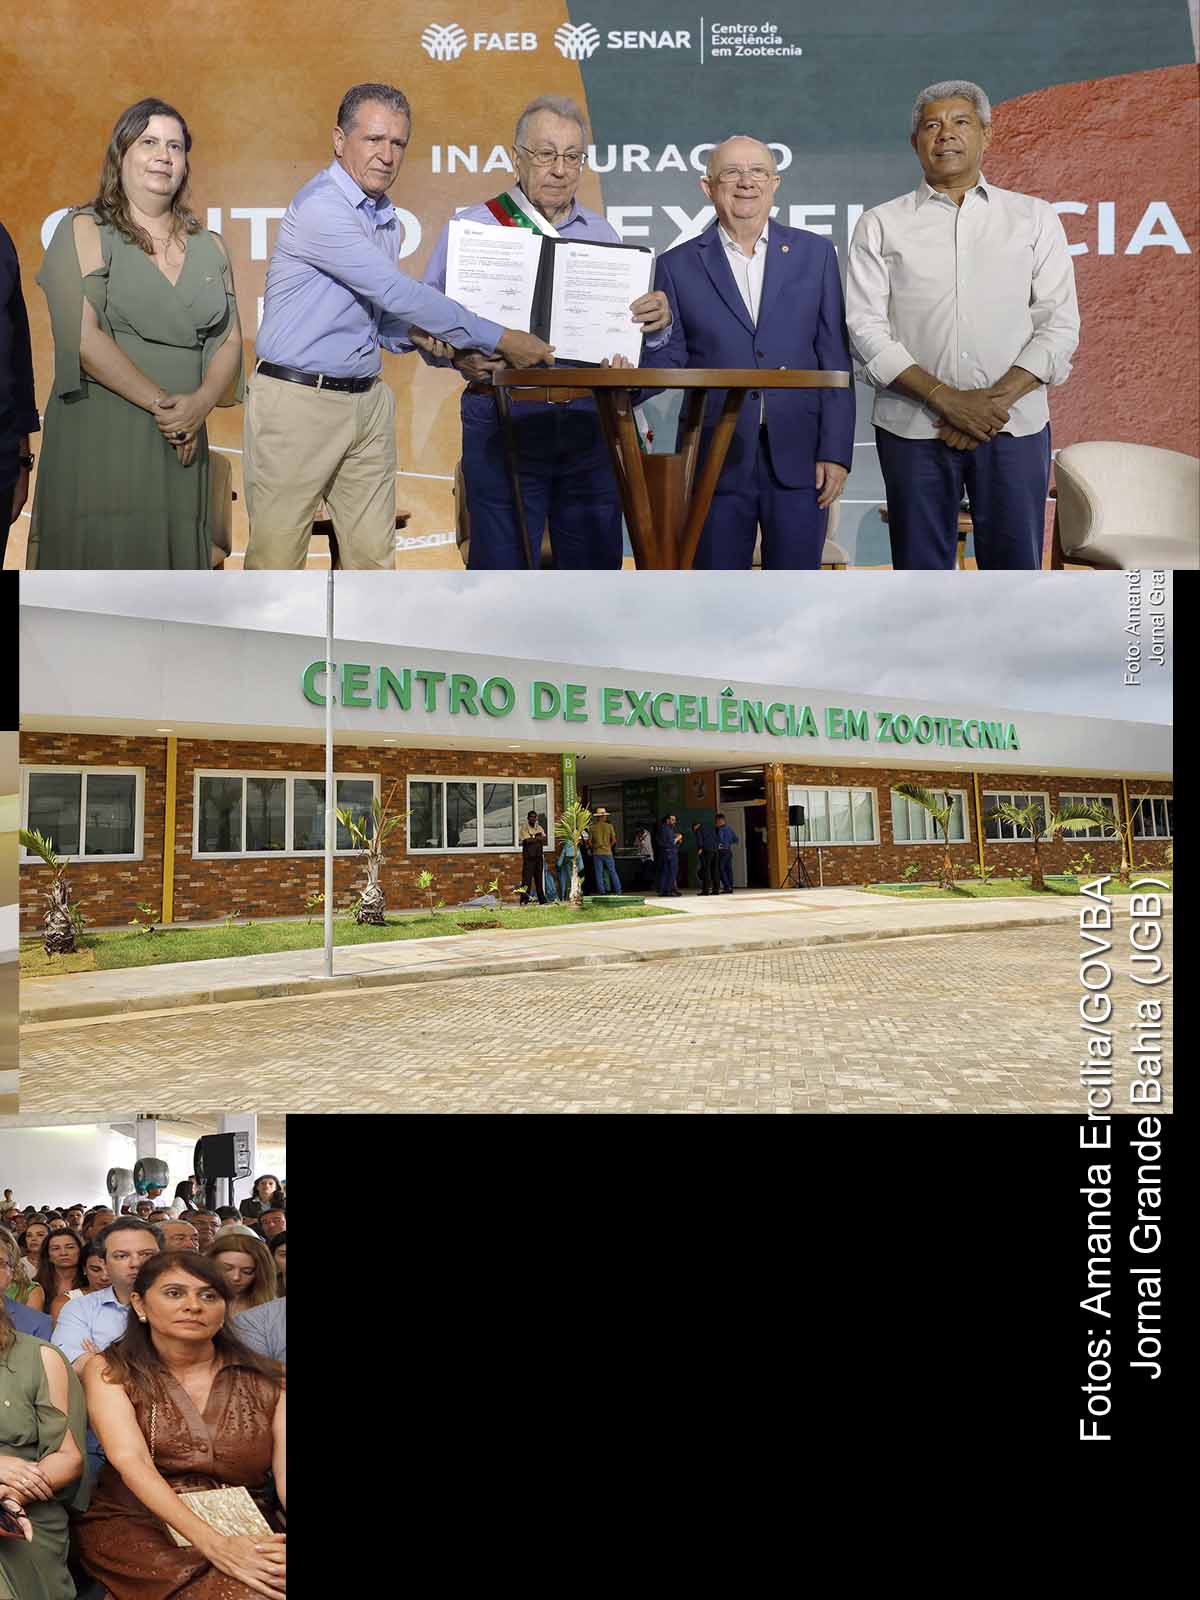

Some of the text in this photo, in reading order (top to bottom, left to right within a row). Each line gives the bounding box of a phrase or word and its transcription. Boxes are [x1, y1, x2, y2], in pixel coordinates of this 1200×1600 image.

[711, 21, 778, 34] Centro de
[473, 32, 538, 51] FAEB
[607, 30, 692, 49] SENAR
[711, 33, 783, 45] Excelência
[711, 44, 803, 56] em Zootecnia
[302, 660, 1021, 750] CENTRO DE EXCELÊNCIA EM ZOOTECNIA
[565, 758, 572, 769] B
